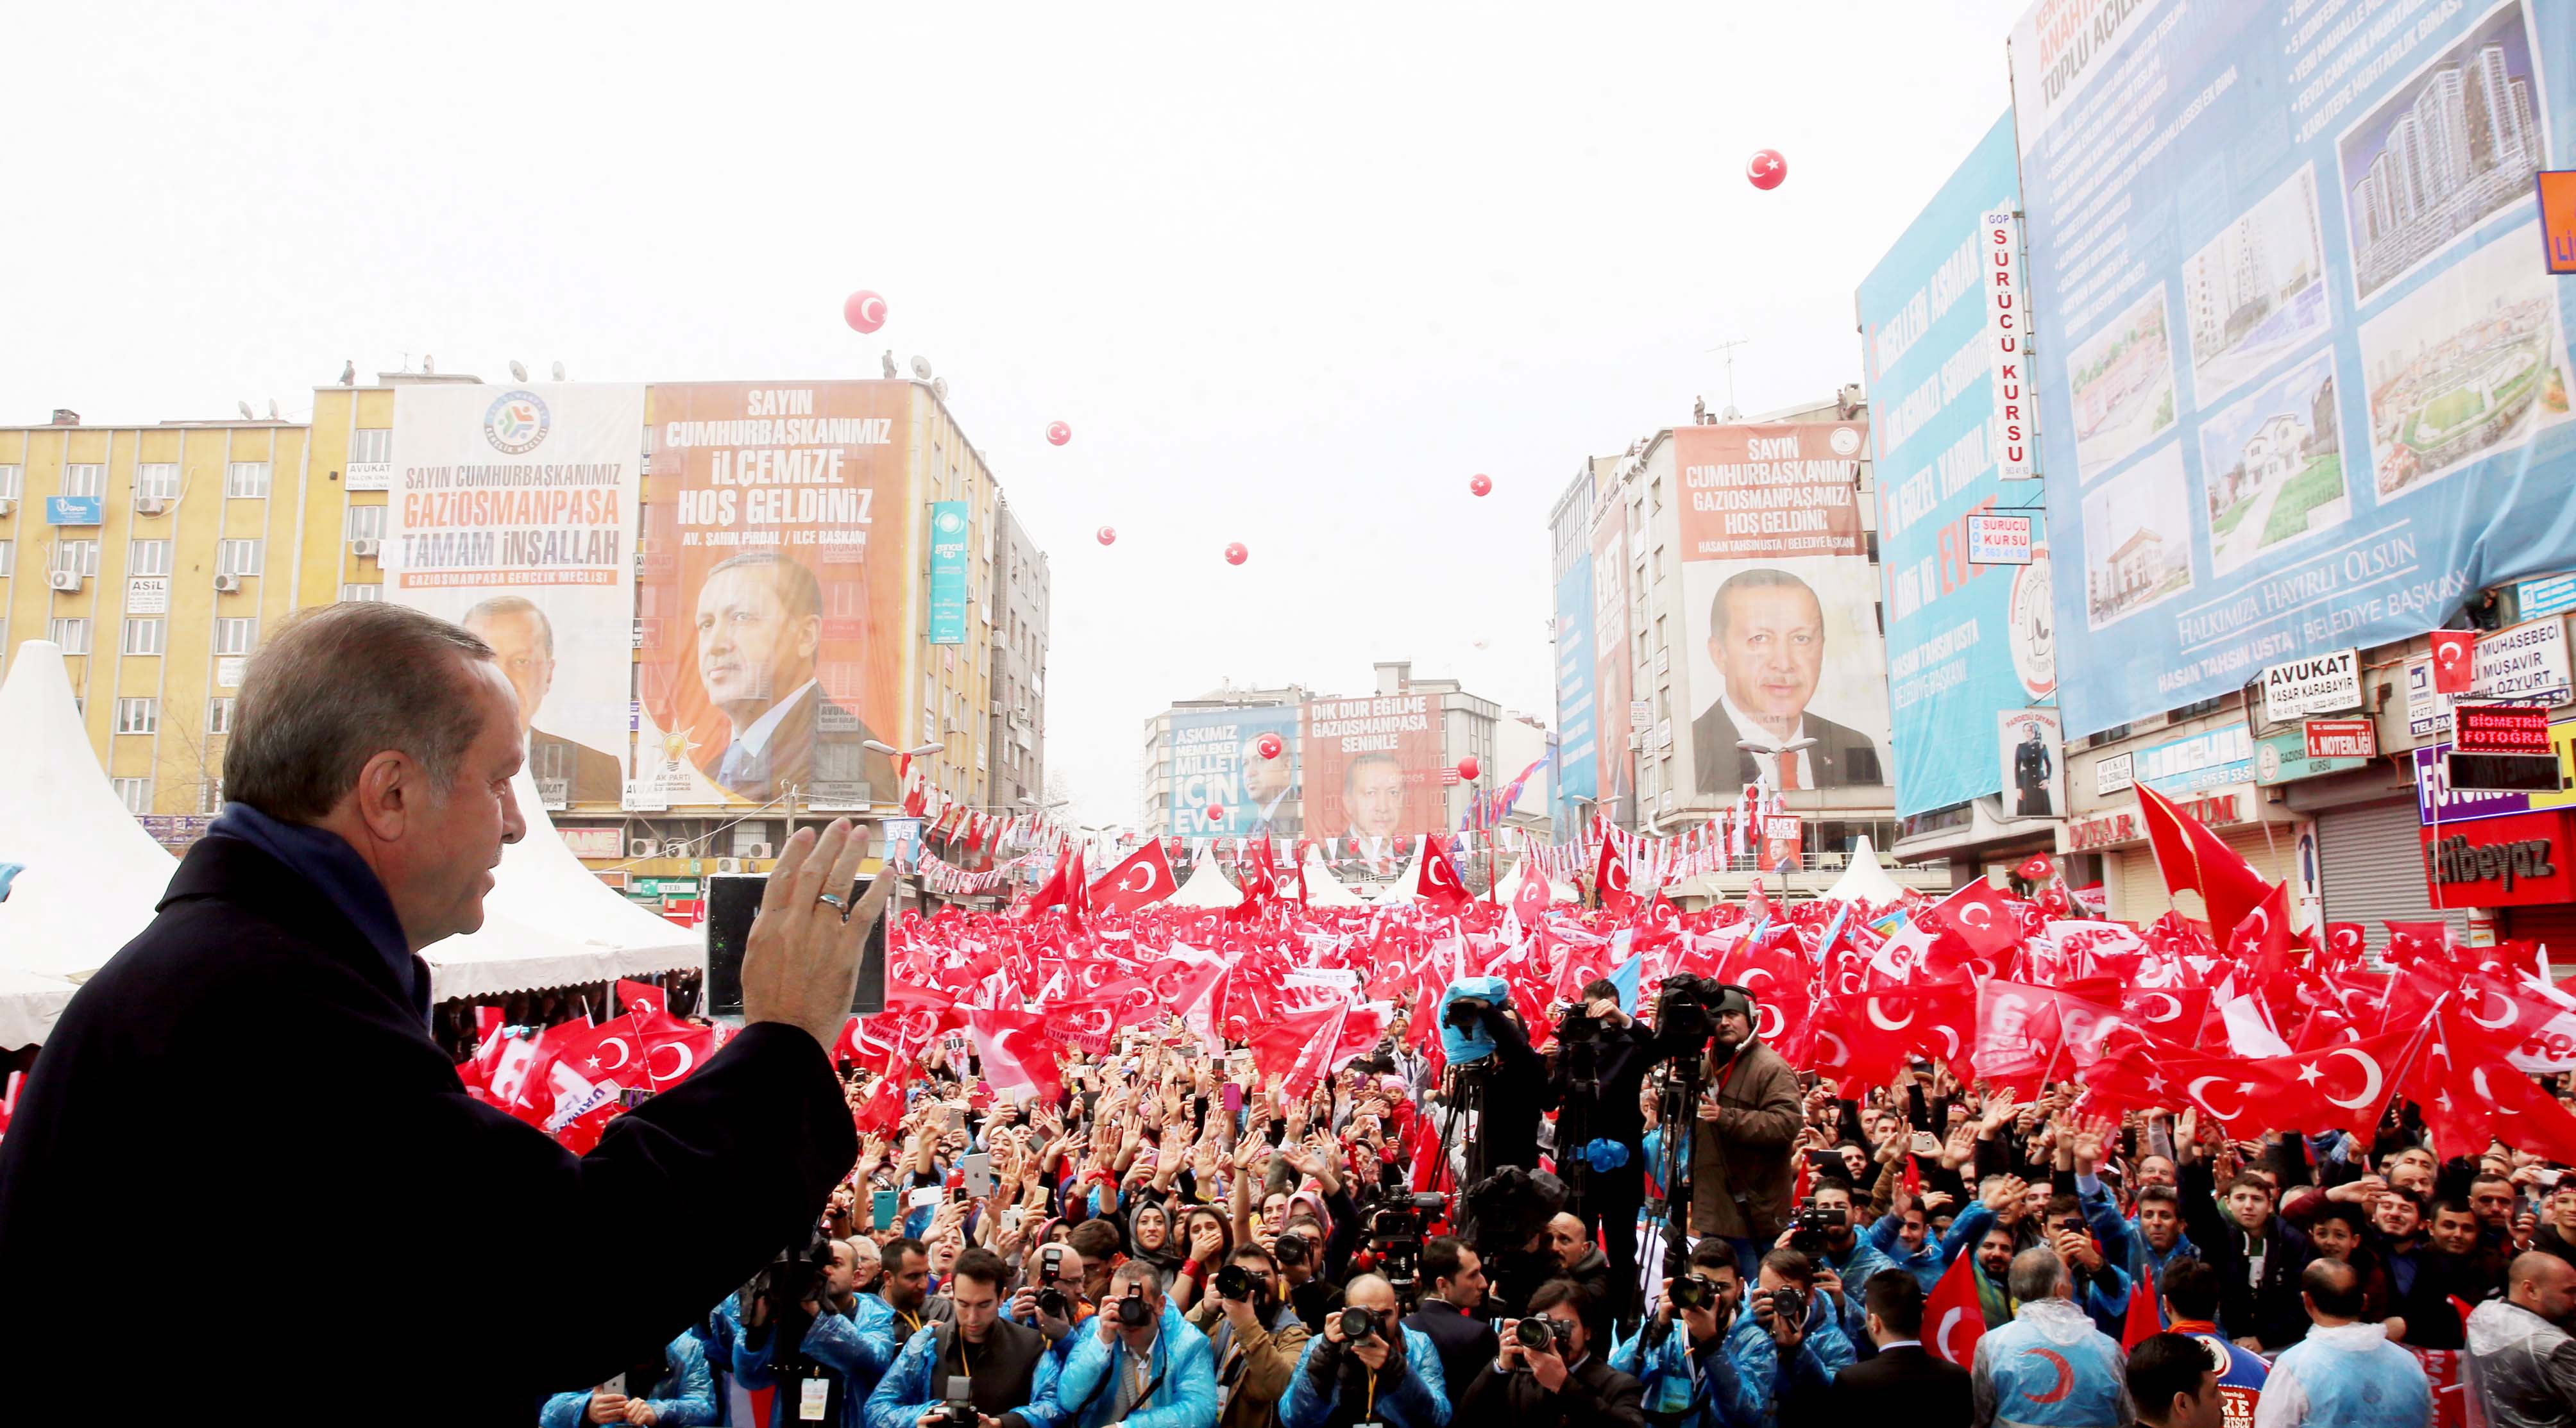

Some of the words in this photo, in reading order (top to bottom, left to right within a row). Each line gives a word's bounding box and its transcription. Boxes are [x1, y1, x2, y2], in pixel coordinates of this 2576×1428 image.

[2042, 30, 2089, 109] TOPLU
[1988, 215, 2009, 224] GOP
[1994, 229, 2015, 351] SÜRÜCÜ
[748, 389, 813, 416] SAYIN
[2003, 365, 2023, 462] KURSU
[666, 418, 892, 447] CUMHURBAŞKANIMIZ
[1747, 436, 1800, 461] SAYIN
[350, 464, 391, 473] AVUKAT
[405, 466, 451, 489] SAYIN
[456, 463, 621, 488] CUMHURBAŞKANIMIZ
[677, 489, 737, 526] HOŞ
[1724, 513, 1759, 536] HOŞ
[402, 531, 493, 567] TAMAM
[1698, 541, 1728, 553] HASAN
[1984, 533, 2028, 546] KURSU
[2178, 594, 2262, 646] HALKIMIZA
[2262, 563, 2339, 613] HAYIRLI
[2344, 533, 2418, 582] OLSUN
[2482, 620, 2559, 657] MUHASEBECİ
[2158, 665, 2201, 693] HASAN
[2253, 631, 2294, 660] USTA
[2271, 654, 2350, 687] AVUKAT
[2484, 650, 2543, 678] MÜŞAVİR
[2302, 677, 2353, 698] KARABAYIR
[1339, 700, 1369, 719] DUR
[1176, 741, 1238, 757] MEMLEKET
[2309, 736, 2319, 755] 1.
[2321, 732, 2372, 756] NOTERLİĞİ
[1767, 818, 1797, 830] EVET
